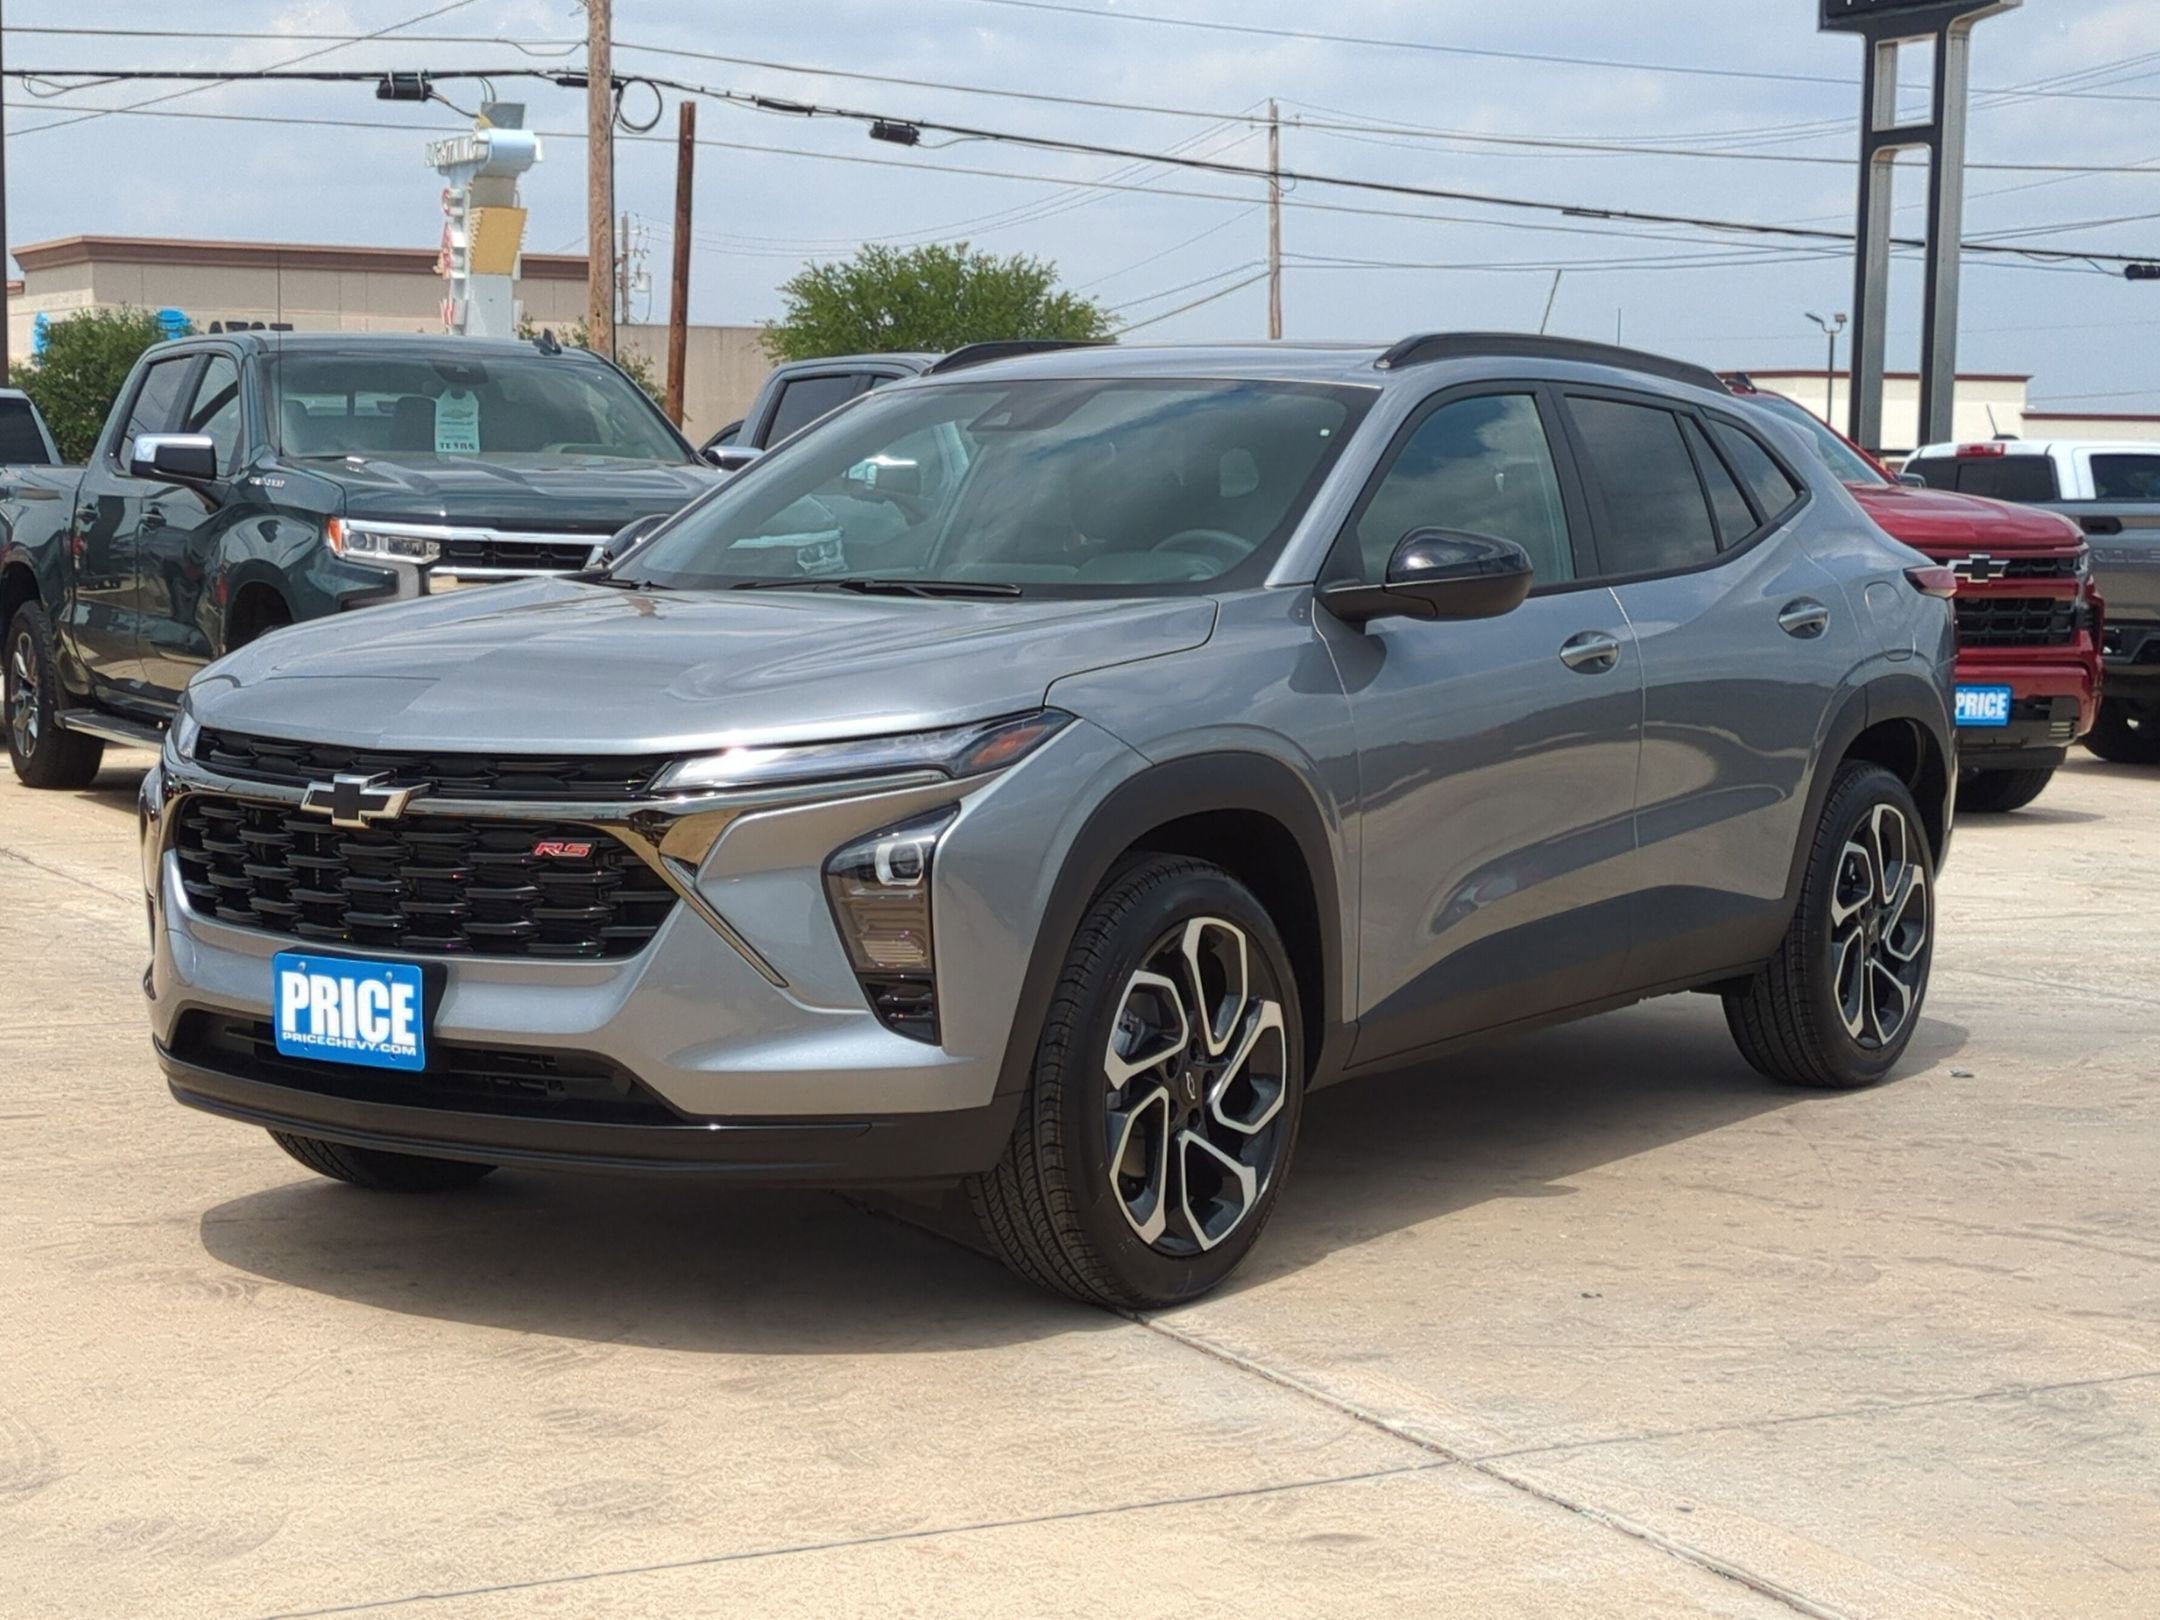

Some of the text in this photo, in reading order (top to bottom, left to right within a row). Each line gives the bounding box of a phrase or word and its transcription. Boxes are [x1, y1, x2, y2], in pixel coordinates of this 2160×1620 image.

[1955, 692, 2008, 717] PRICE
[534, 842, 592, 857] RS
[281, 971, 416, 1046] PRICE
[282, 1031, 417, 1057] PRICECHEVY.COM
